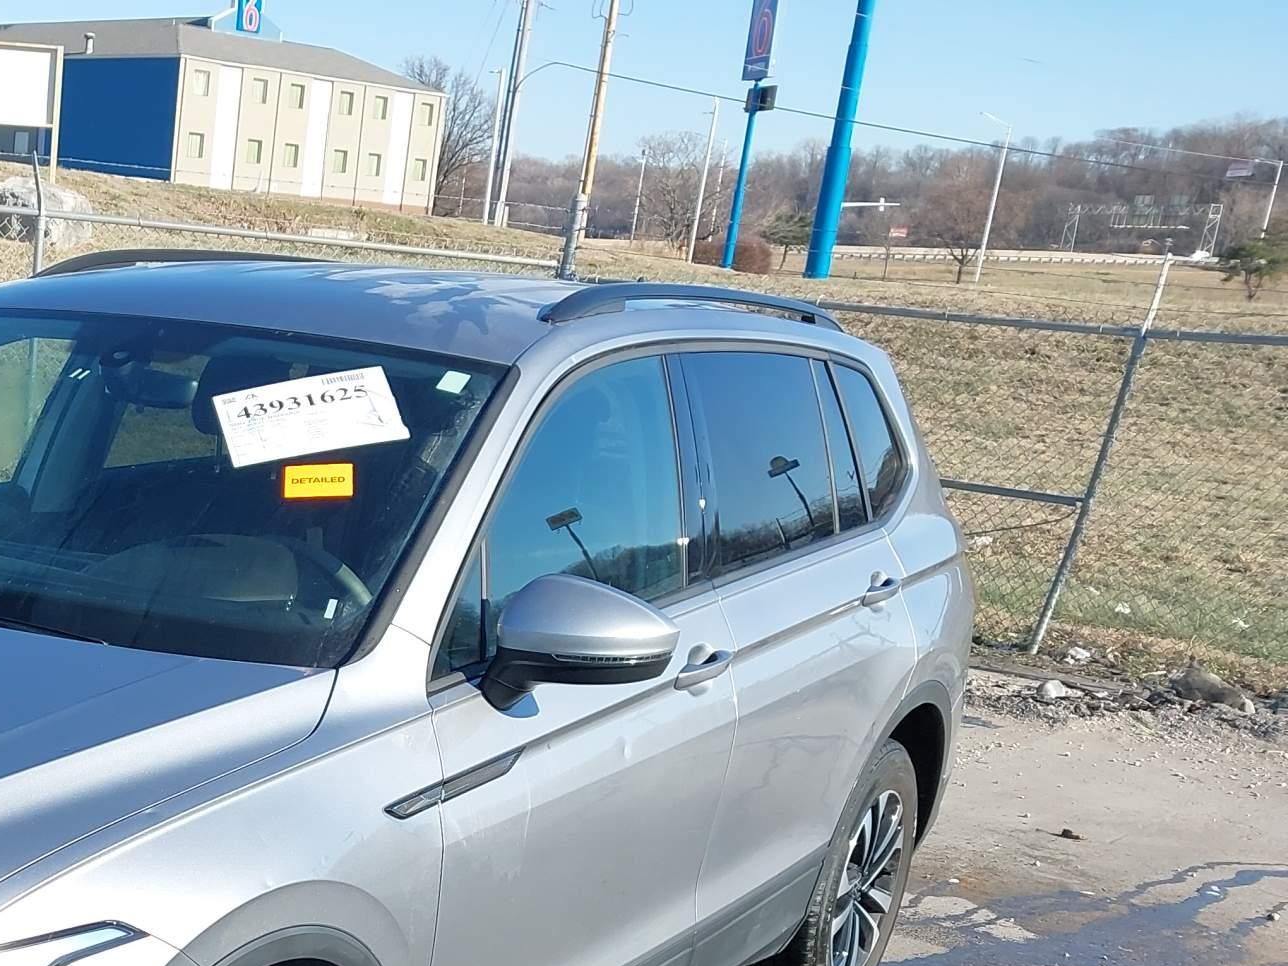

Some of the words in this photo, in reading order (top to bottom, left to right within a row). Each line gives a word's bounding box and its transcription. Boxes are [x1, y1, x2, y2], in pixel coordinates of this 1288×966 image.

[243, 0, 259, 32] 6
[753, 0, 773, 57] 6
[237, 385, 369, 419] 43931625
[291, 475, 346, 485] DETAILED
